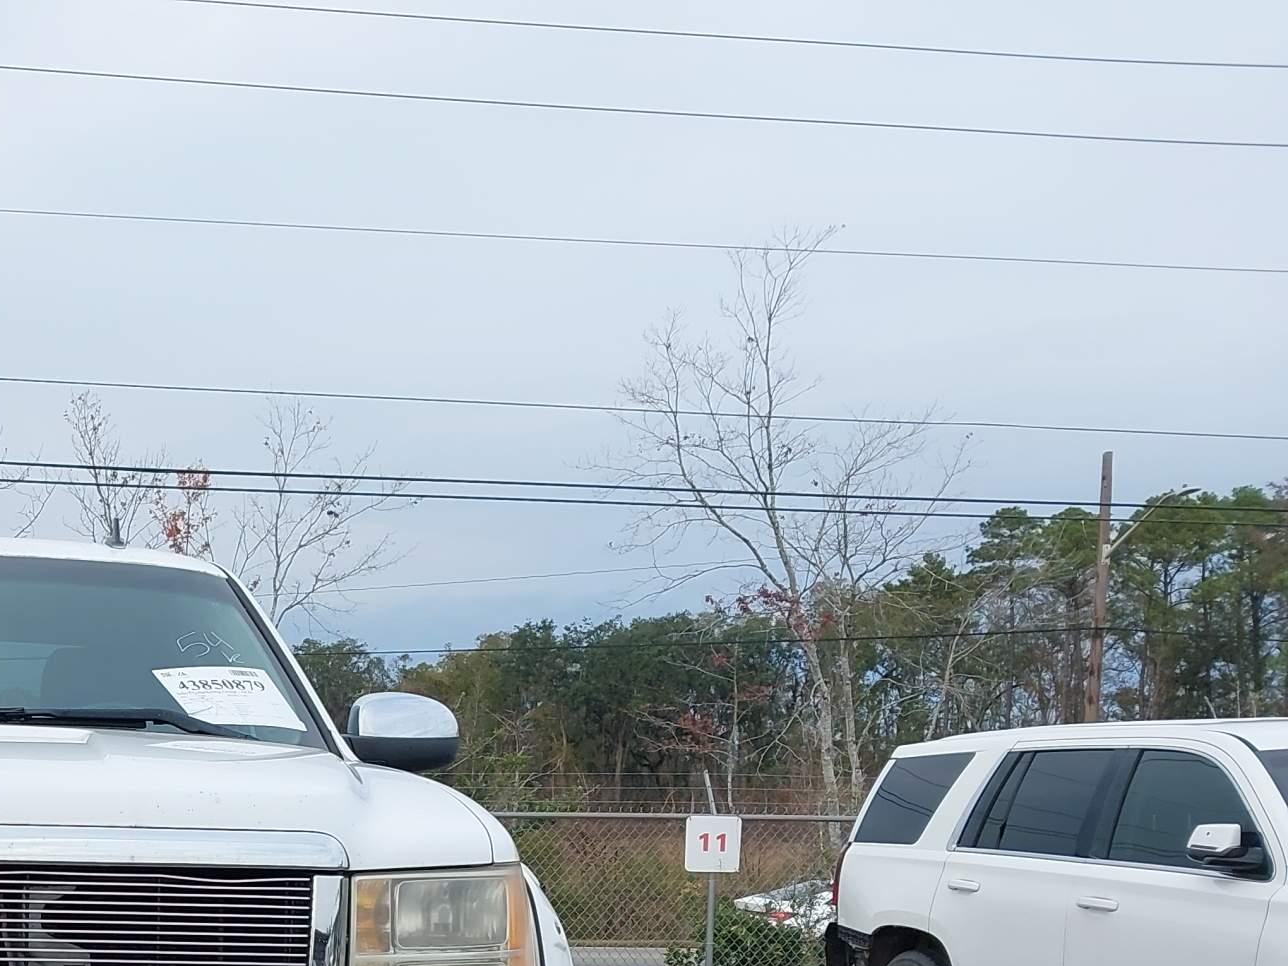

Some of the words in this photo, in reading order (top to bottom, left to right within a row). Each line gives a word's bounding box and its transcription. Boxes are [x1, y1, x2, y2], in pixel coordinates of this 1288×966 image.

[176, 632, 234, 657] 54
[178, 679, 265, 691] 43850879
[698, 832, 727, 852] 11
